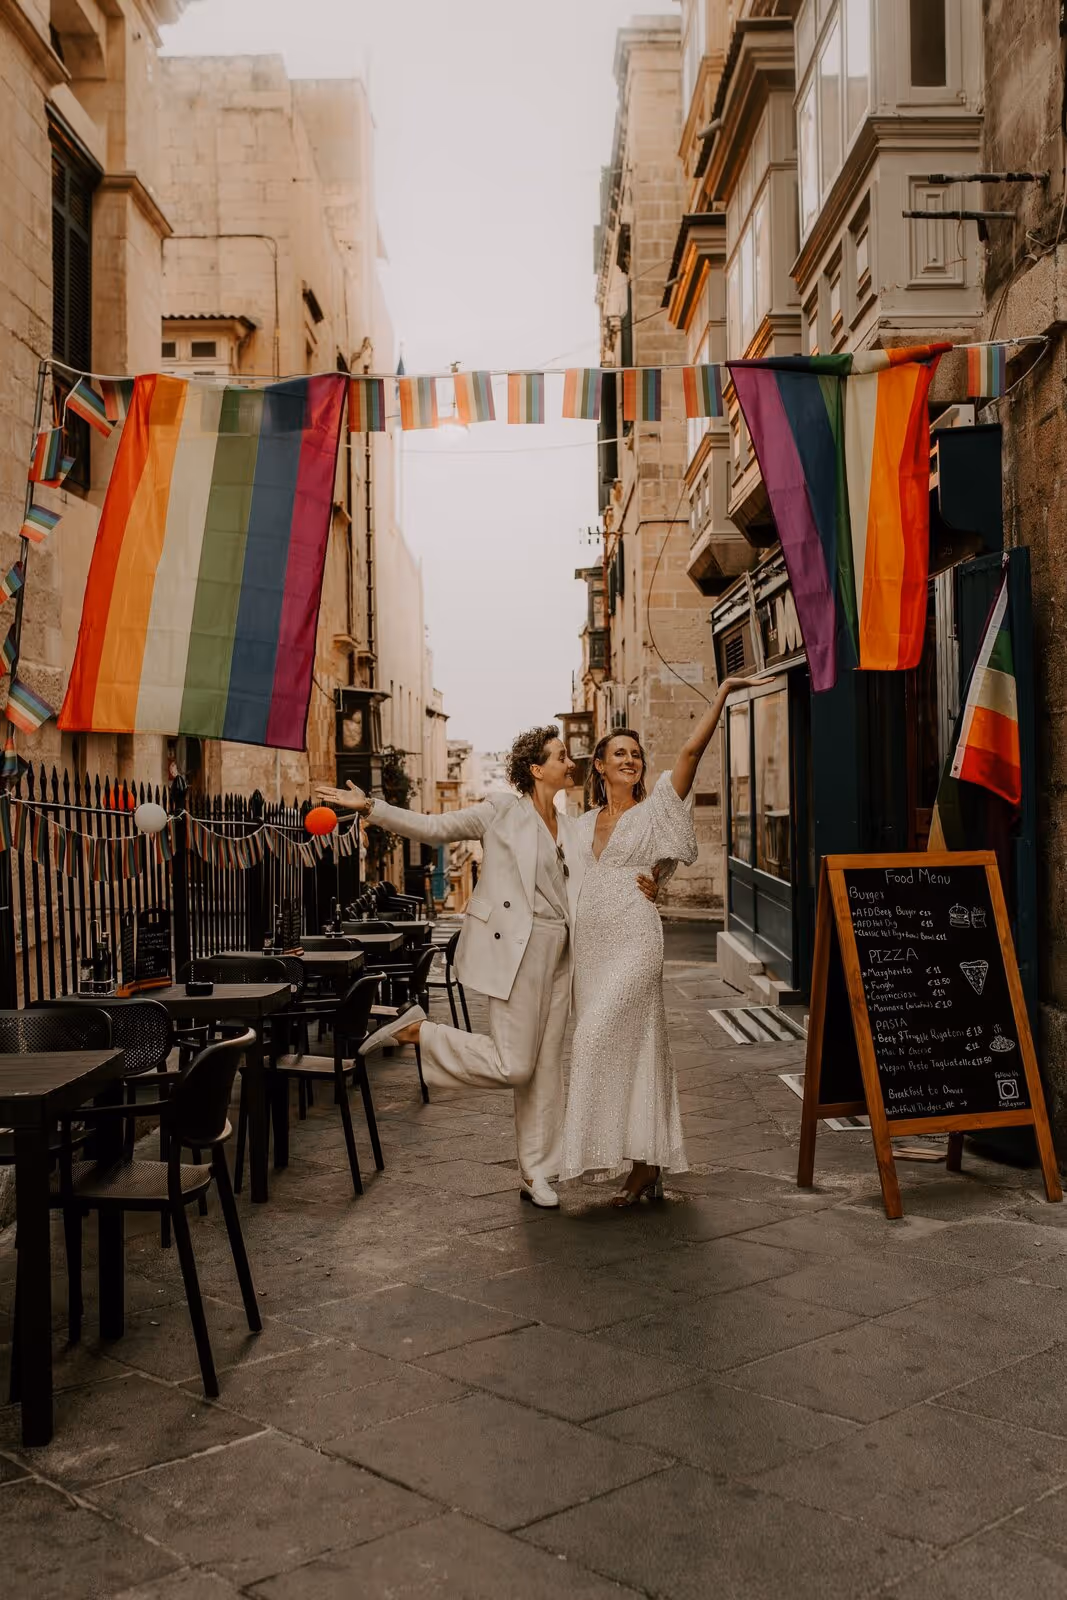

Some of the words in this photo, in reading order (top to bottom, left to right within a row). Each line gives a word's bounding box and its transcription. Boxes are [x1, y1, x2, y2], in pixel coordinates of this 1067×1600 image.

[885, 868, 914, 885] Food
[918, 868, 951, 884] Menu
[849, 886, 884, 904] Burger
[868, 948, 919, 964] PIZZA
[876, 1018, 908, 1032] PASTA
[928, 1085, 938, 1096] to
